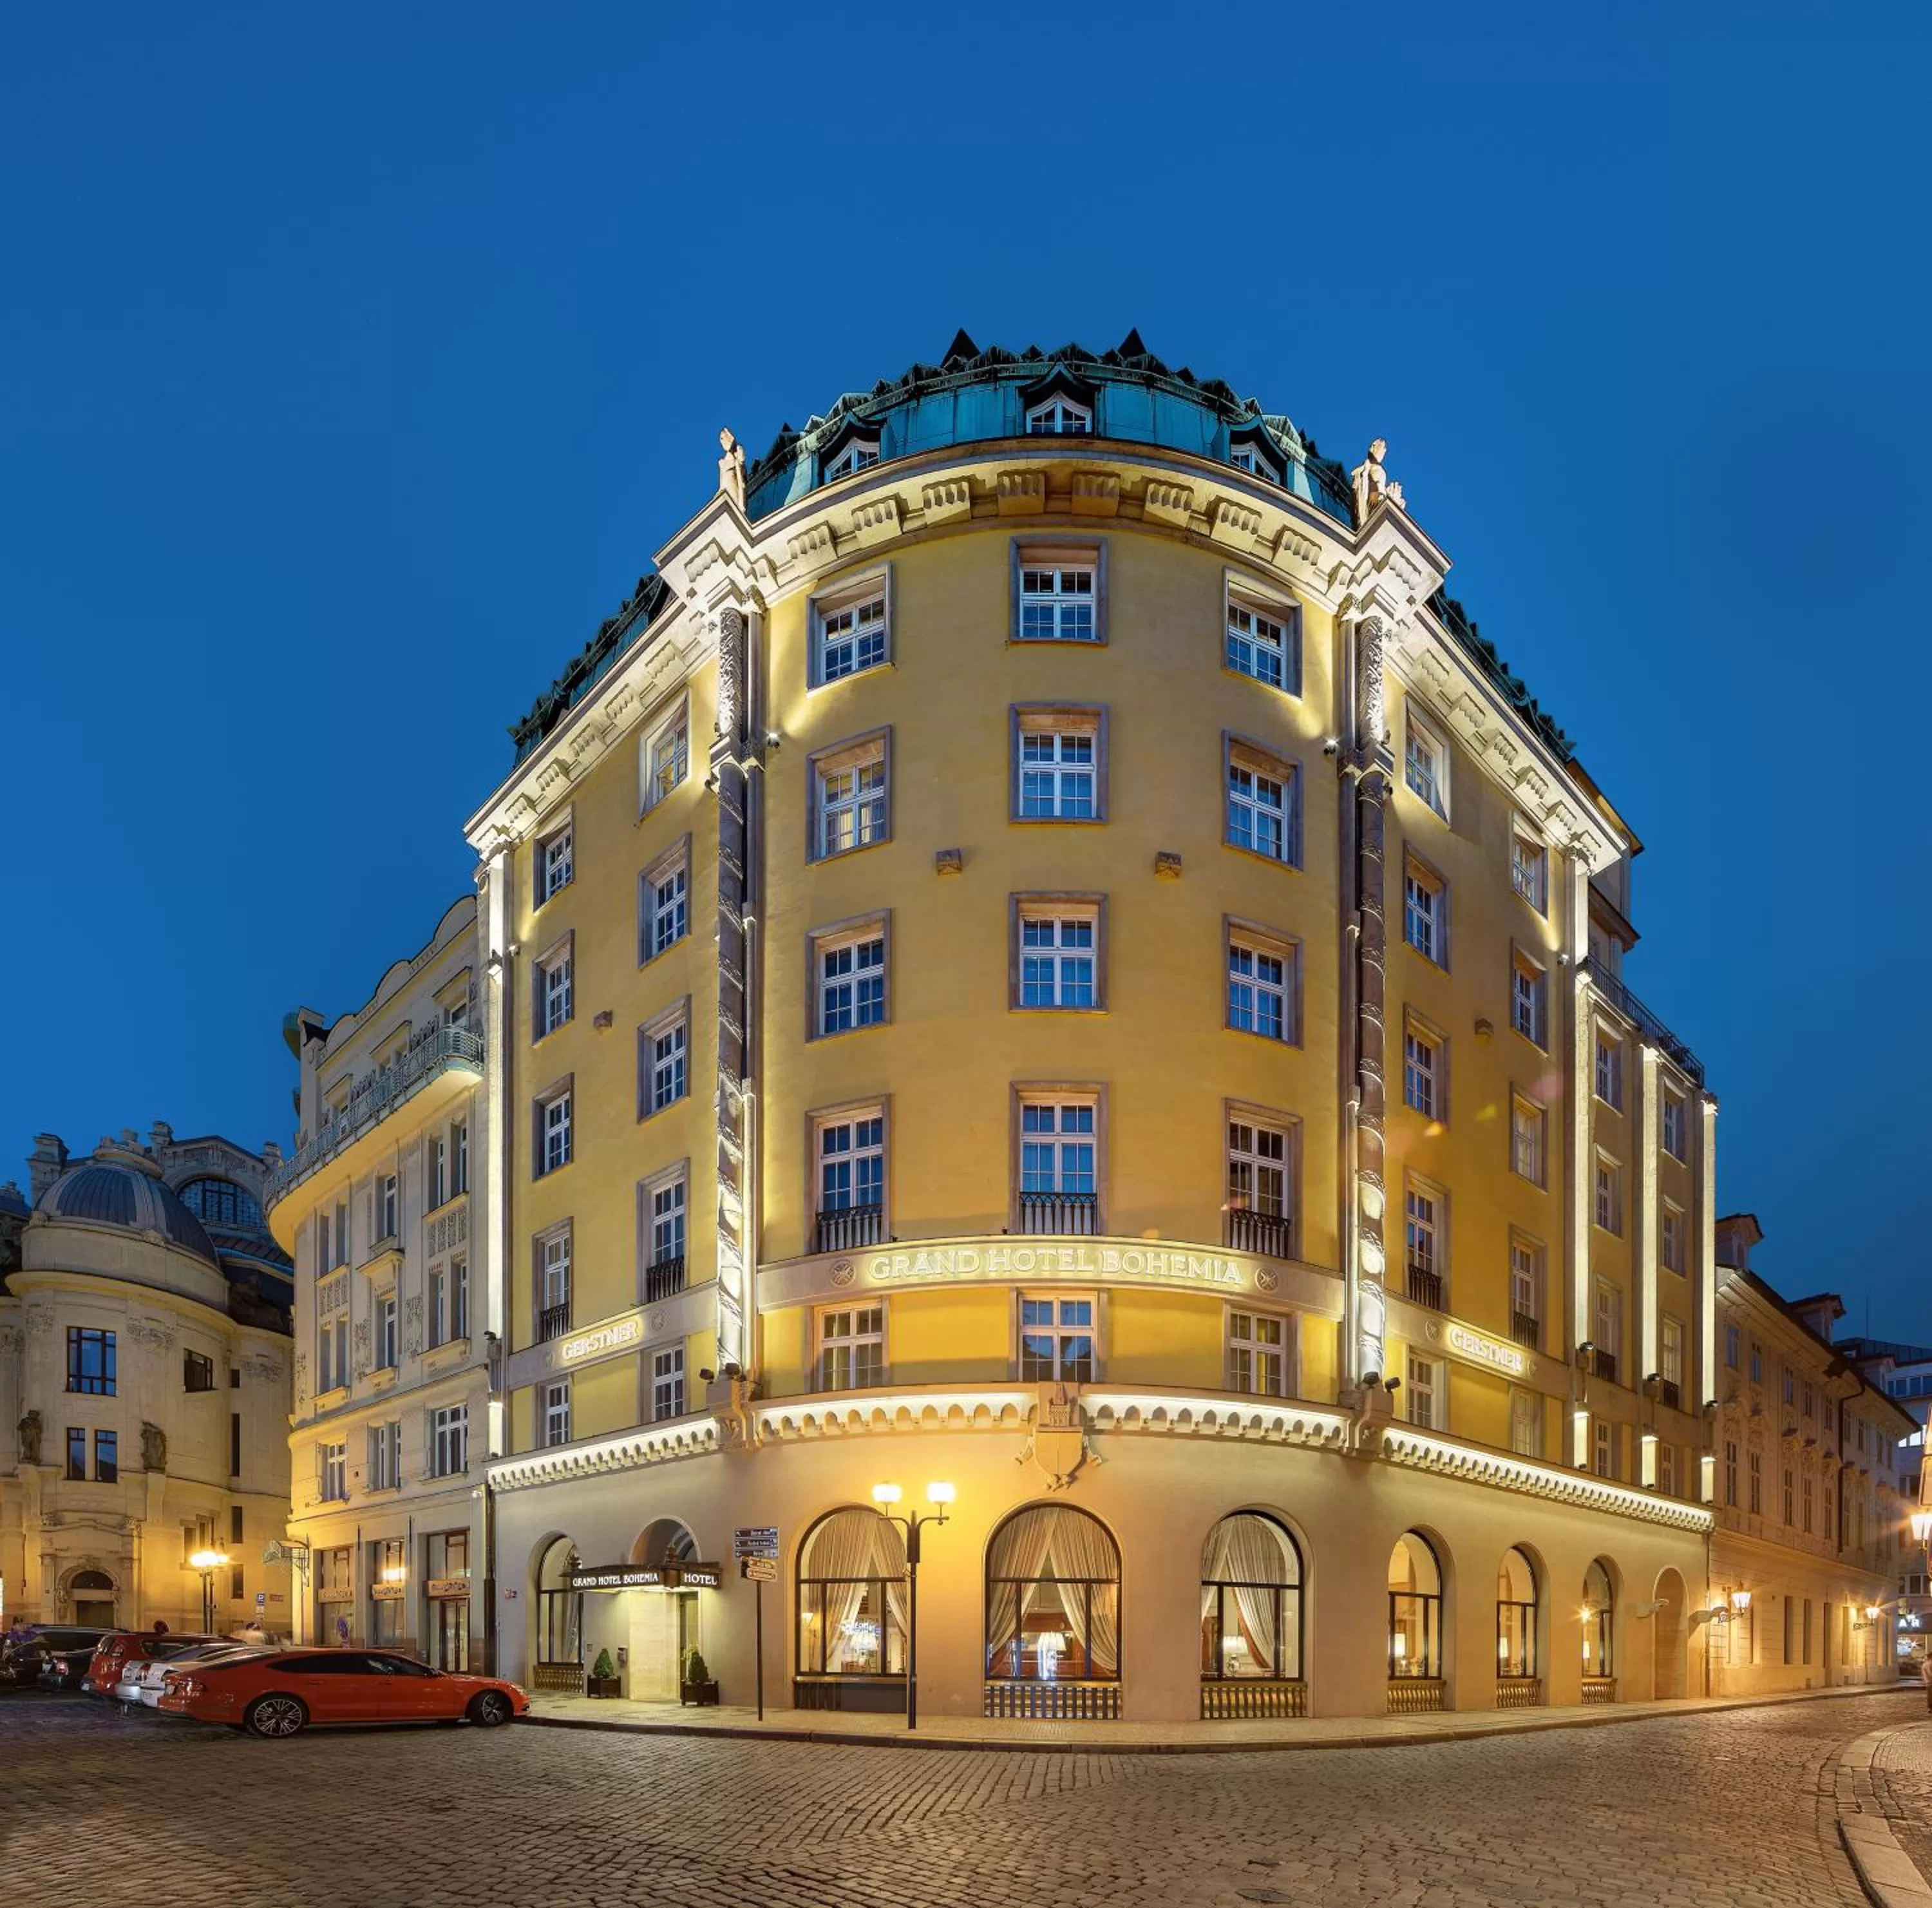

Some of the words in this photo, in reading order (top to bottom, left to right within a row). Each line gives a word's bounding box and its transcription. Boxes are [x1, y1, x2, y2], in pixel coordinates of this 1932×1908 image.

[870, 1249, 980, 1279] GRAND
[988, 1248, 1094, 1272] HOTEL
[1101, 1250, 1243, 1284] BOHEMIA
[563, 1321, 637, 1360] GERSTNER
[1451, 1328, 1522, 1371] GERSTNER
[573, 1576, 597, 1587] GRAND
[598, 1574, 621, 1585] HOTEL
[623, 1572, 659, 1584] BOHEMIA
[684, 1573, 717, 1585] HOTEL
